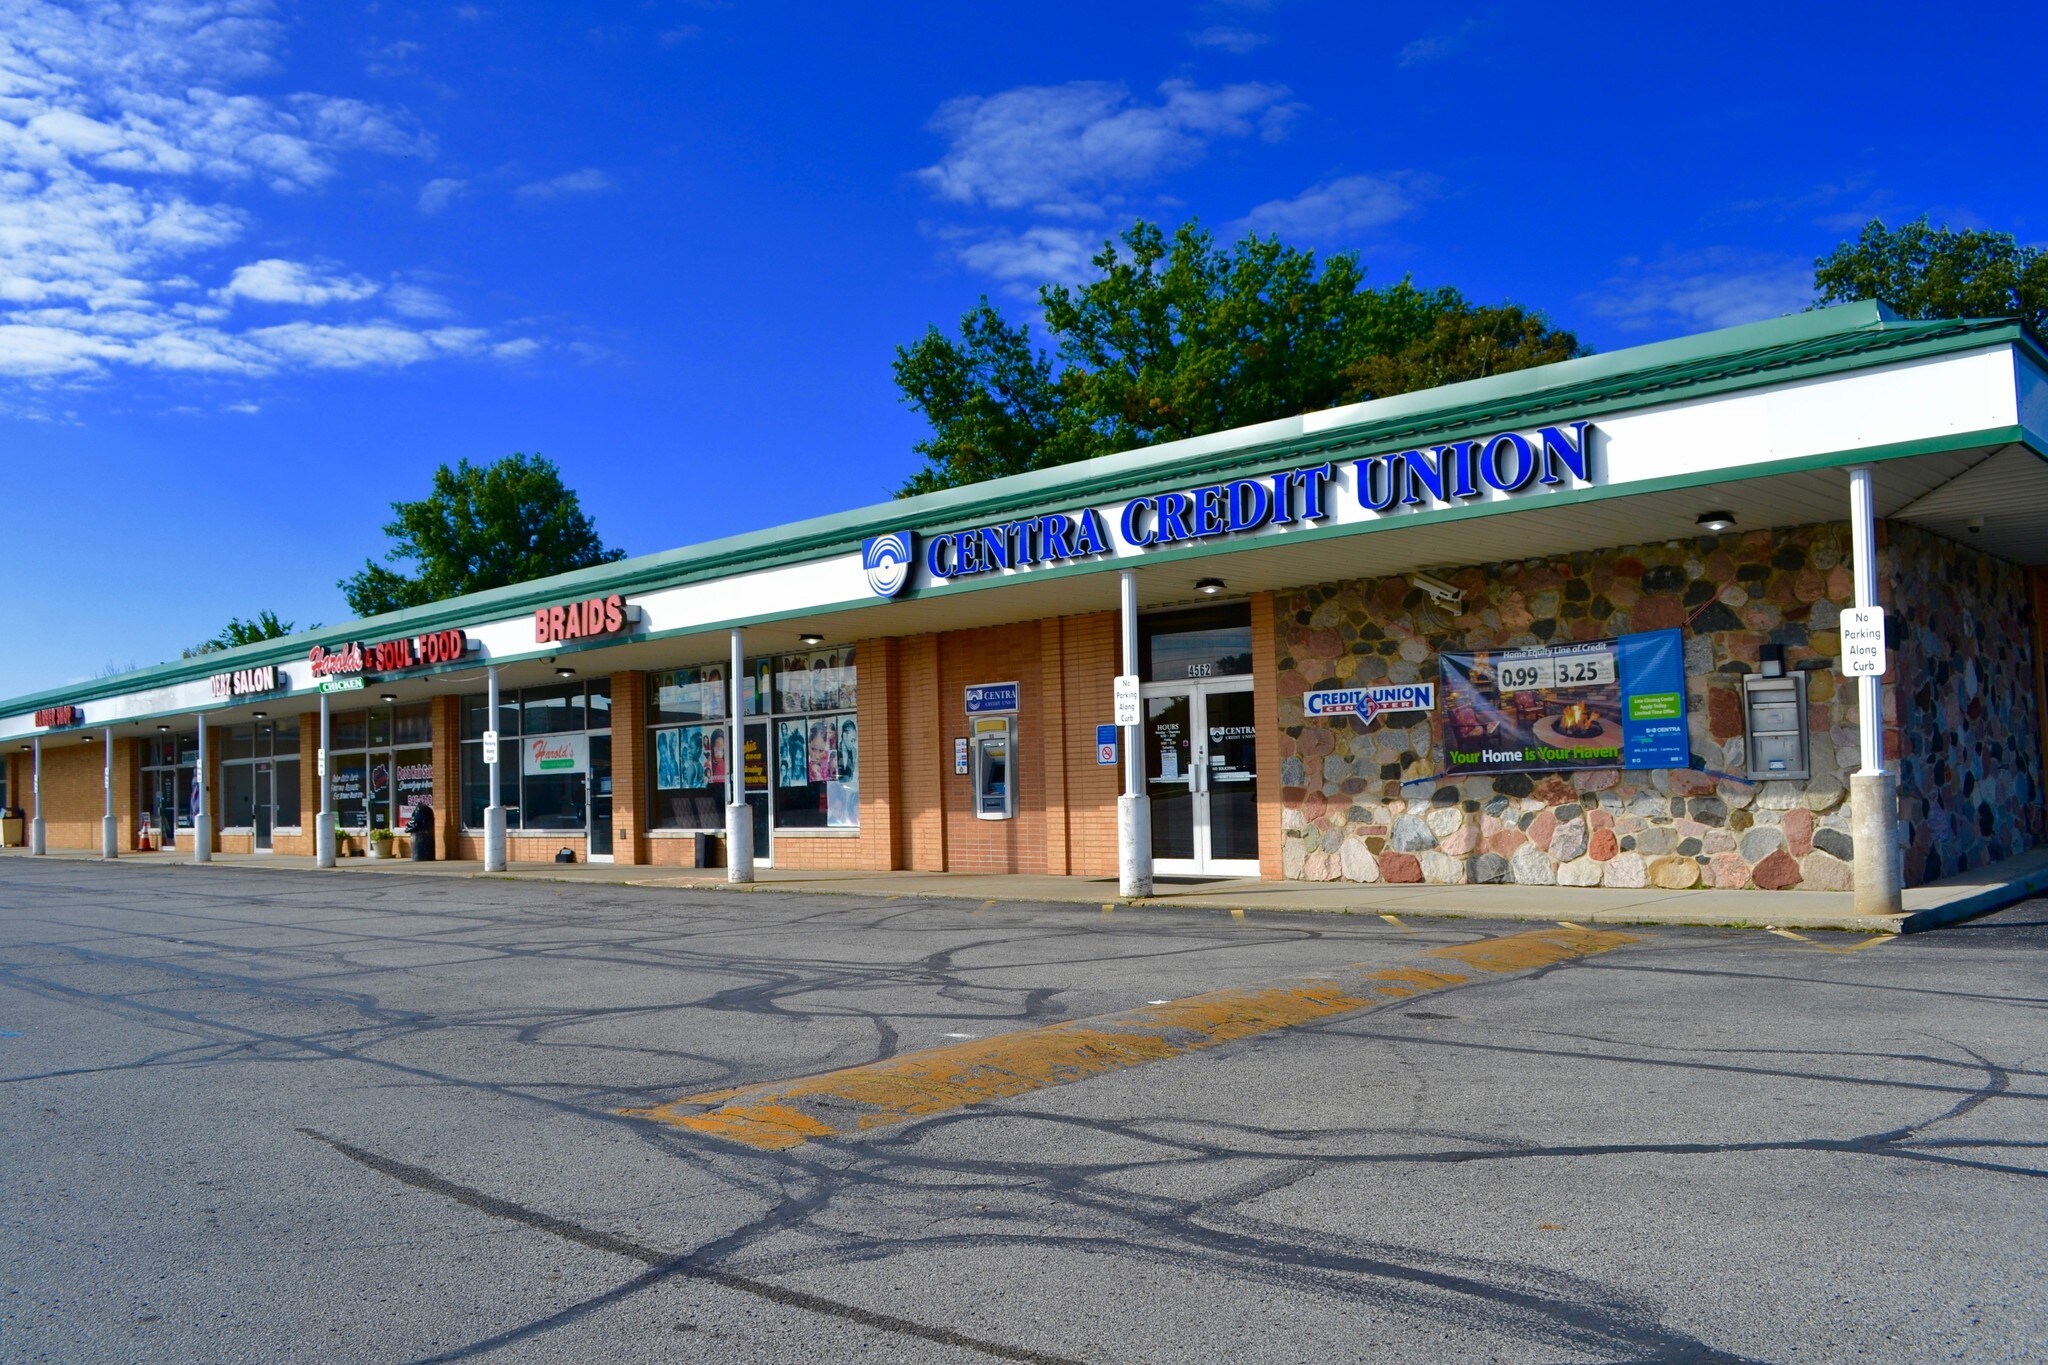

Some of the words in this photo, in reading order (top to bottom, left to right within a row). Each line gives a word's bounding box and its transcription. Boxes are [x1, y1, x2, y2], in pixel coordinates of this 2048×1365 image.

[928, 507, 1107, 578] CENTRA
[1120, 462, 1331, 546] CREDIT
[1353, 420, 1588, 510] UNION
[535, 594, 622, 643] BRAIDS
[1855, 613, 1869, 622] No
[1844, 628, 1881, 640] Parking
[365, 648, 373, 668] &
[376, 638, 413, 671] SOUL
[419, 628, 461, 664] FOOD
[1503, 650, 1526, 659] Home
[1528, 648, 1552, 659] Equity
[1554, 646, 1571, 655] Line
[1572, 644, 1580, 653] of
[1582, 642, 1607, 651] Credit
[1849, 645, 1877, 657] Along
[1189, 665, 1211, 676] 4562
[1853, 660, 1875, 671] Curb
[233, 665, 275, 695] SALON
[322, 678, 362, 692] CHICKEN
[984, 690, 1016, 700] CENTRA
[1116, 691, 1137, 699] Parking
[1308, 691, 1361, 714] CREDIT
[1373, 686, 1430, 707] UNION
[1119, 703, 1135, 711] Along
[1120, 714, 1134, 722] Curb
[1157, 723, 1179, 731] HOURS
[1225, 726, 1256, 735] CENTRA
[532, 738, 575, 763] Harold's
[1450, 750, 1480, 764] Your
[1482, 749, 1522, 763] Home
[1525, 747, 1536, 761] is
[1538, 746, 1571, 760] Your
[1573, 744, 1618, 759] Haven
